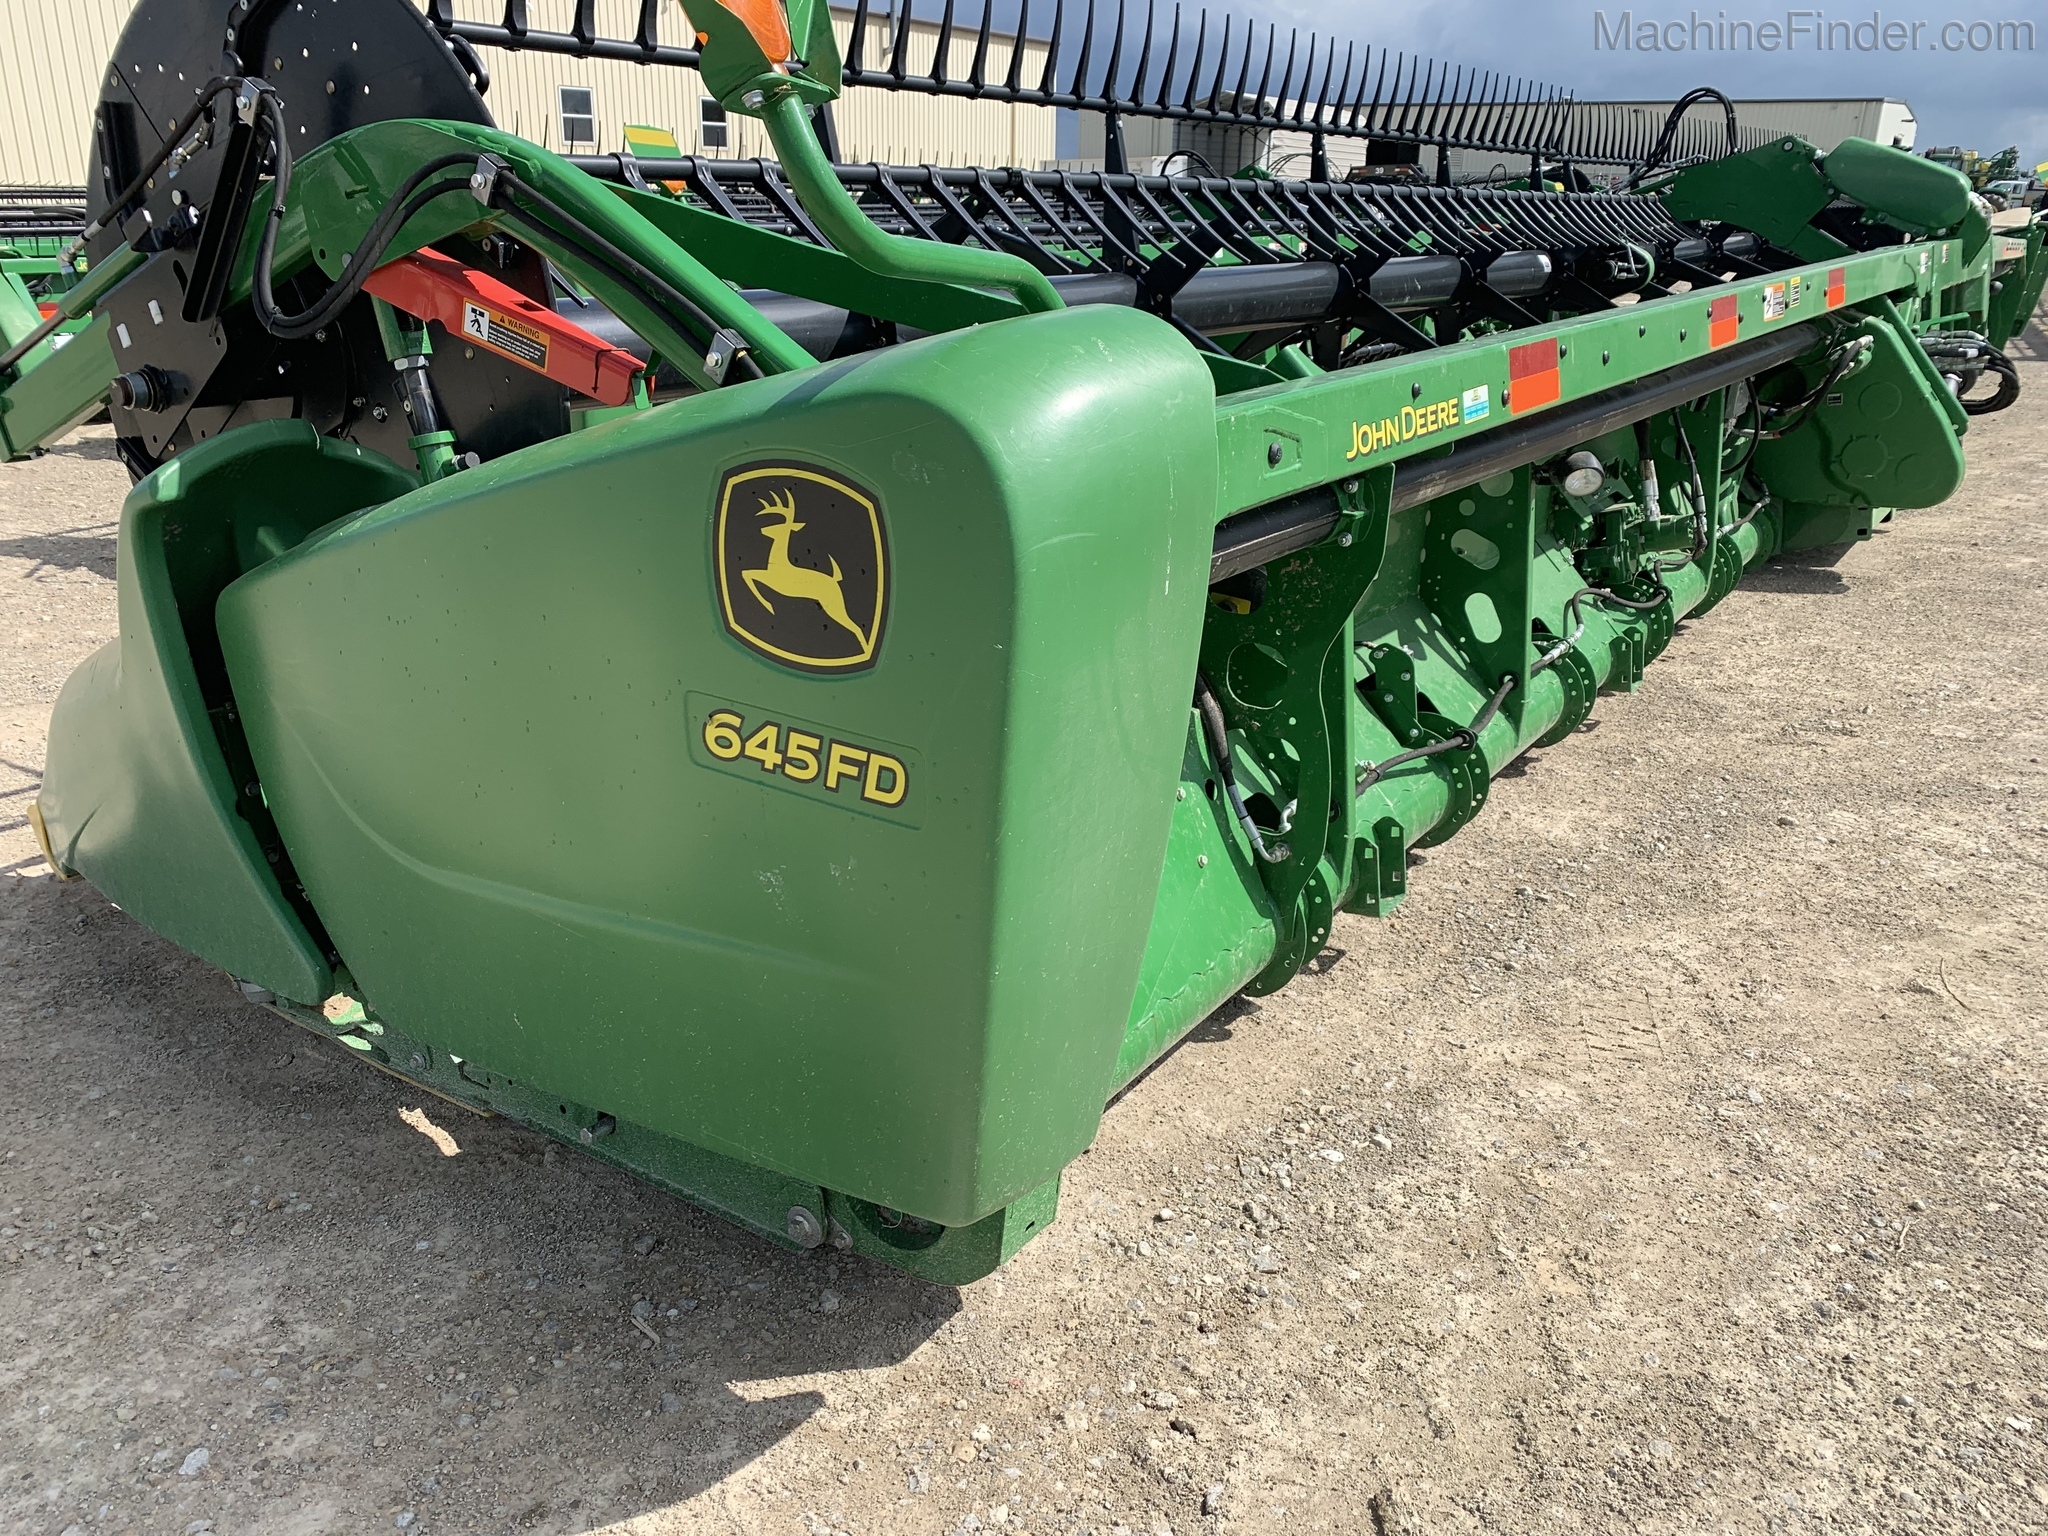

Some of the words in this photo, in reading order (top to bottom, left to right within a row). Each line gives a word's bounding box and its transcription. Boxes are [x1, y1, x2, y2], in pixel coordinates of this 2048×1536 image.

[507, 317, 540, 339] WARNING
[1346, 415, 1400, 461] JOHN
[1401, 397, 1460, 442] DEERE
[703, 708, 909, 808] 645FD
